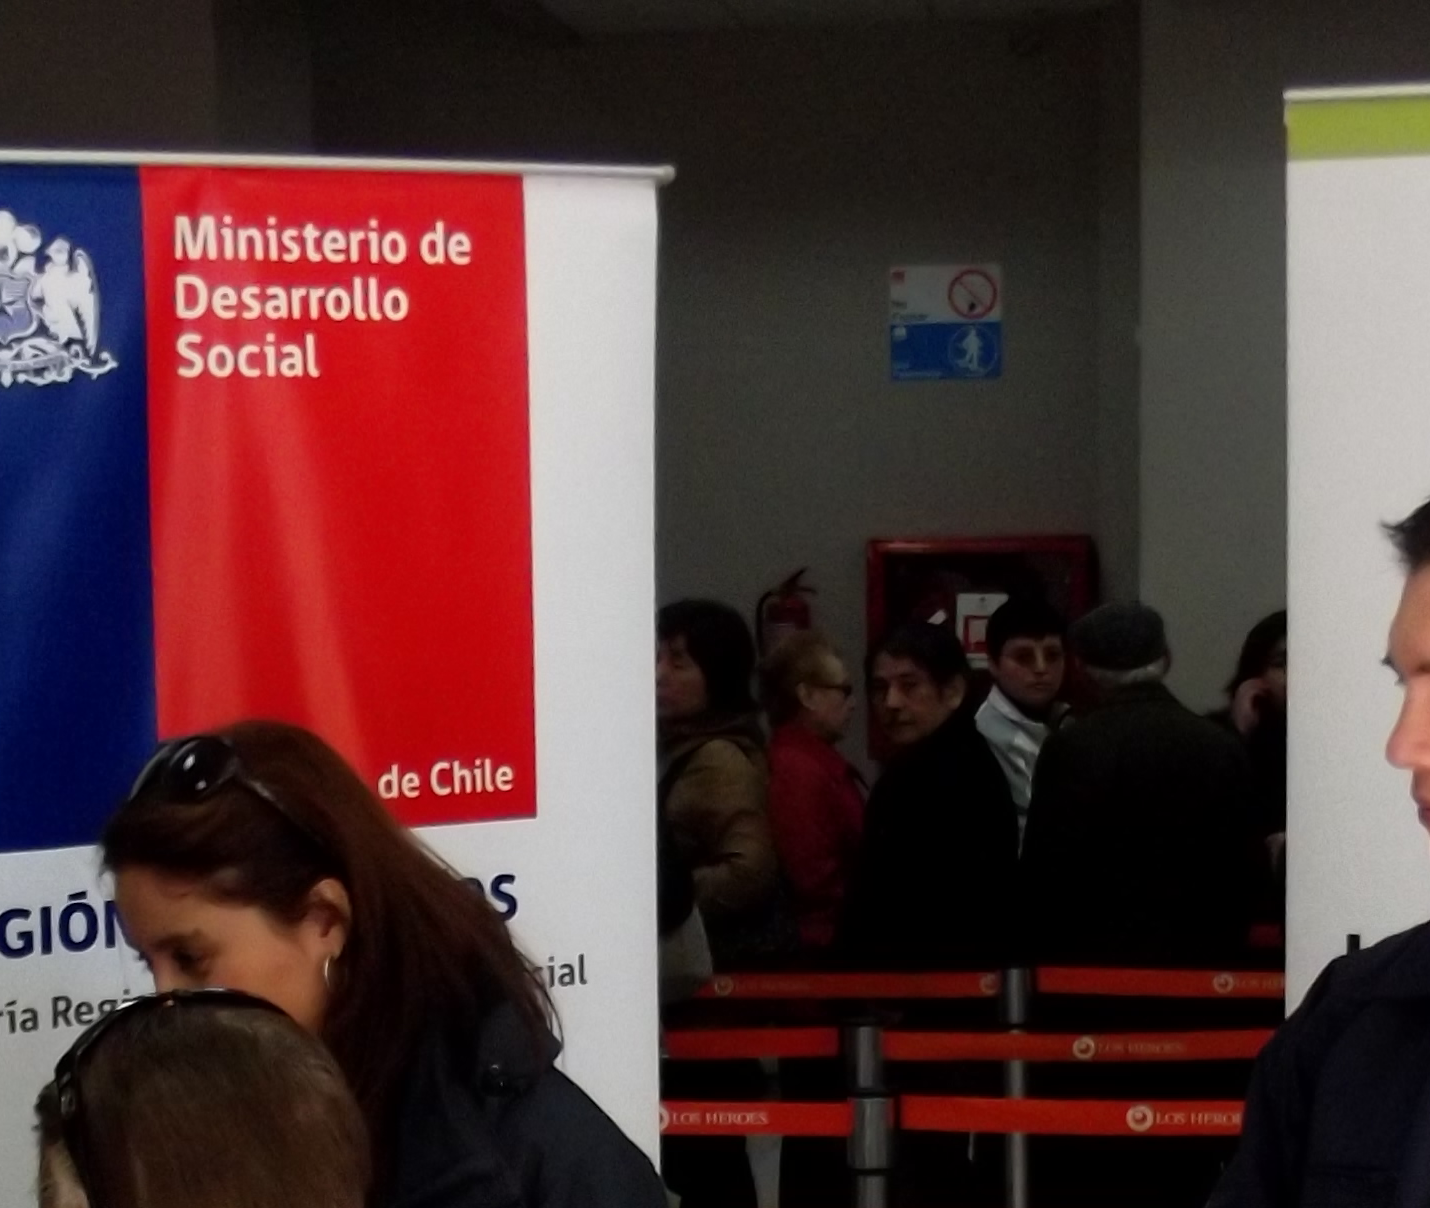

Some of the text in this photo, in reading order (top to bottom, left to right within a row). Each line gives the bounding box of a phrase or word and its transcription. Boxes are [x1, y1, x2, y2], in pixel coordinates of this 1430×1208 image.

[173, 213, 472, 266] Ministerio de
[174, 273, 410, 322] Desarrollo
[175, 331, 321, 379] Social
[376, 757, 514, 799] de Chile
[671, 1111, 769, 1125] LOS HEROES
[1155, 1111, 1186, 1125] LOS
